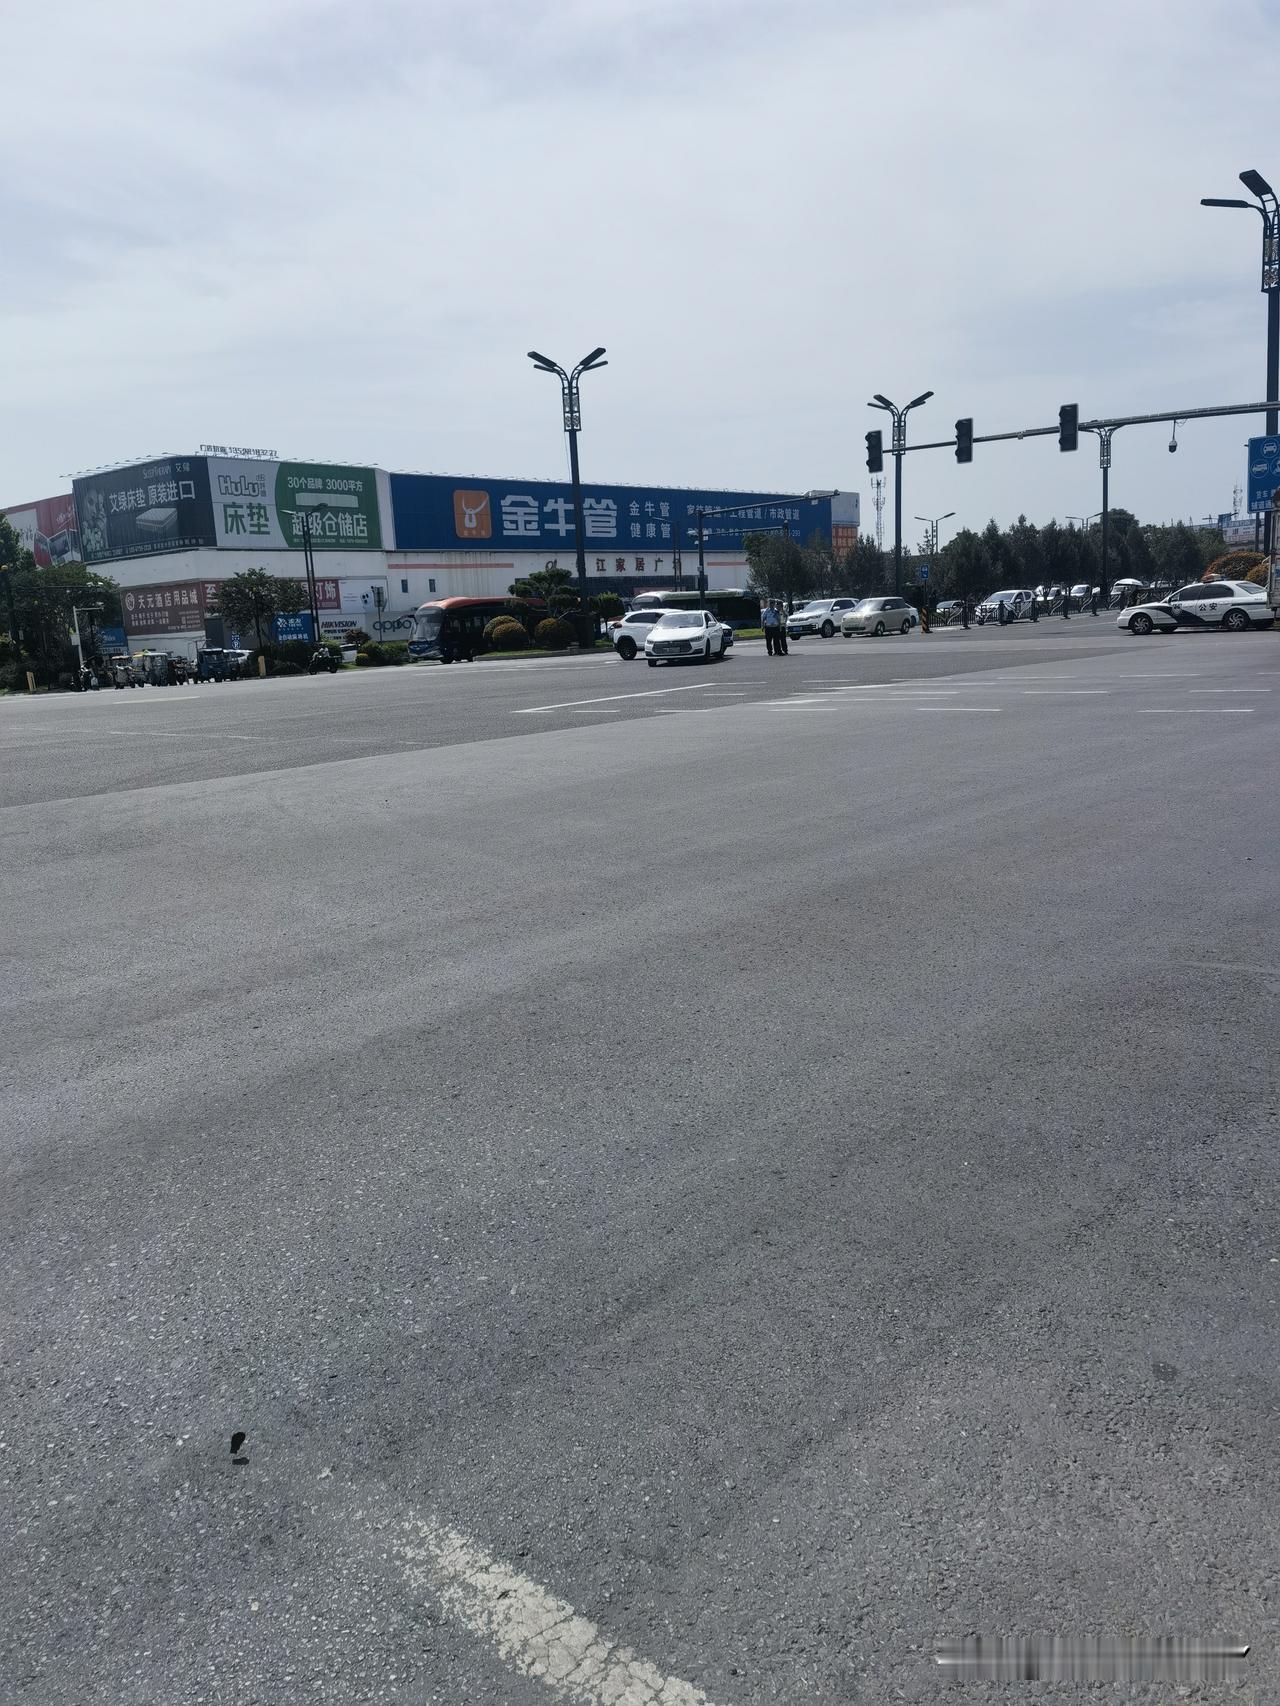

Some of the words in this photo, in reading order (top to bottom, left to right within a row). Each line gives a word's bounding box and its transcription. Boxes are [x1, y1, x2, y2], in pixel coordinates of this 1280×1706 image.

[147, 480, 196, 506] 原装进口
[287, 476, 324, 490] 30个品牌
[326, 478, 364, 493] 3000平方
[629, 499, 671, 518] 金牛管
[223, 501, 271, 536] 床垫
[291, 511, 369, 538] 超级仓储店
[629, 522, 671, 539] 健康管
[138, 589, 199, 609] 天元酒店用品城
[1198, 602, 1218, 612] 公安
[321, 620, 358, 629] HIKVISION
